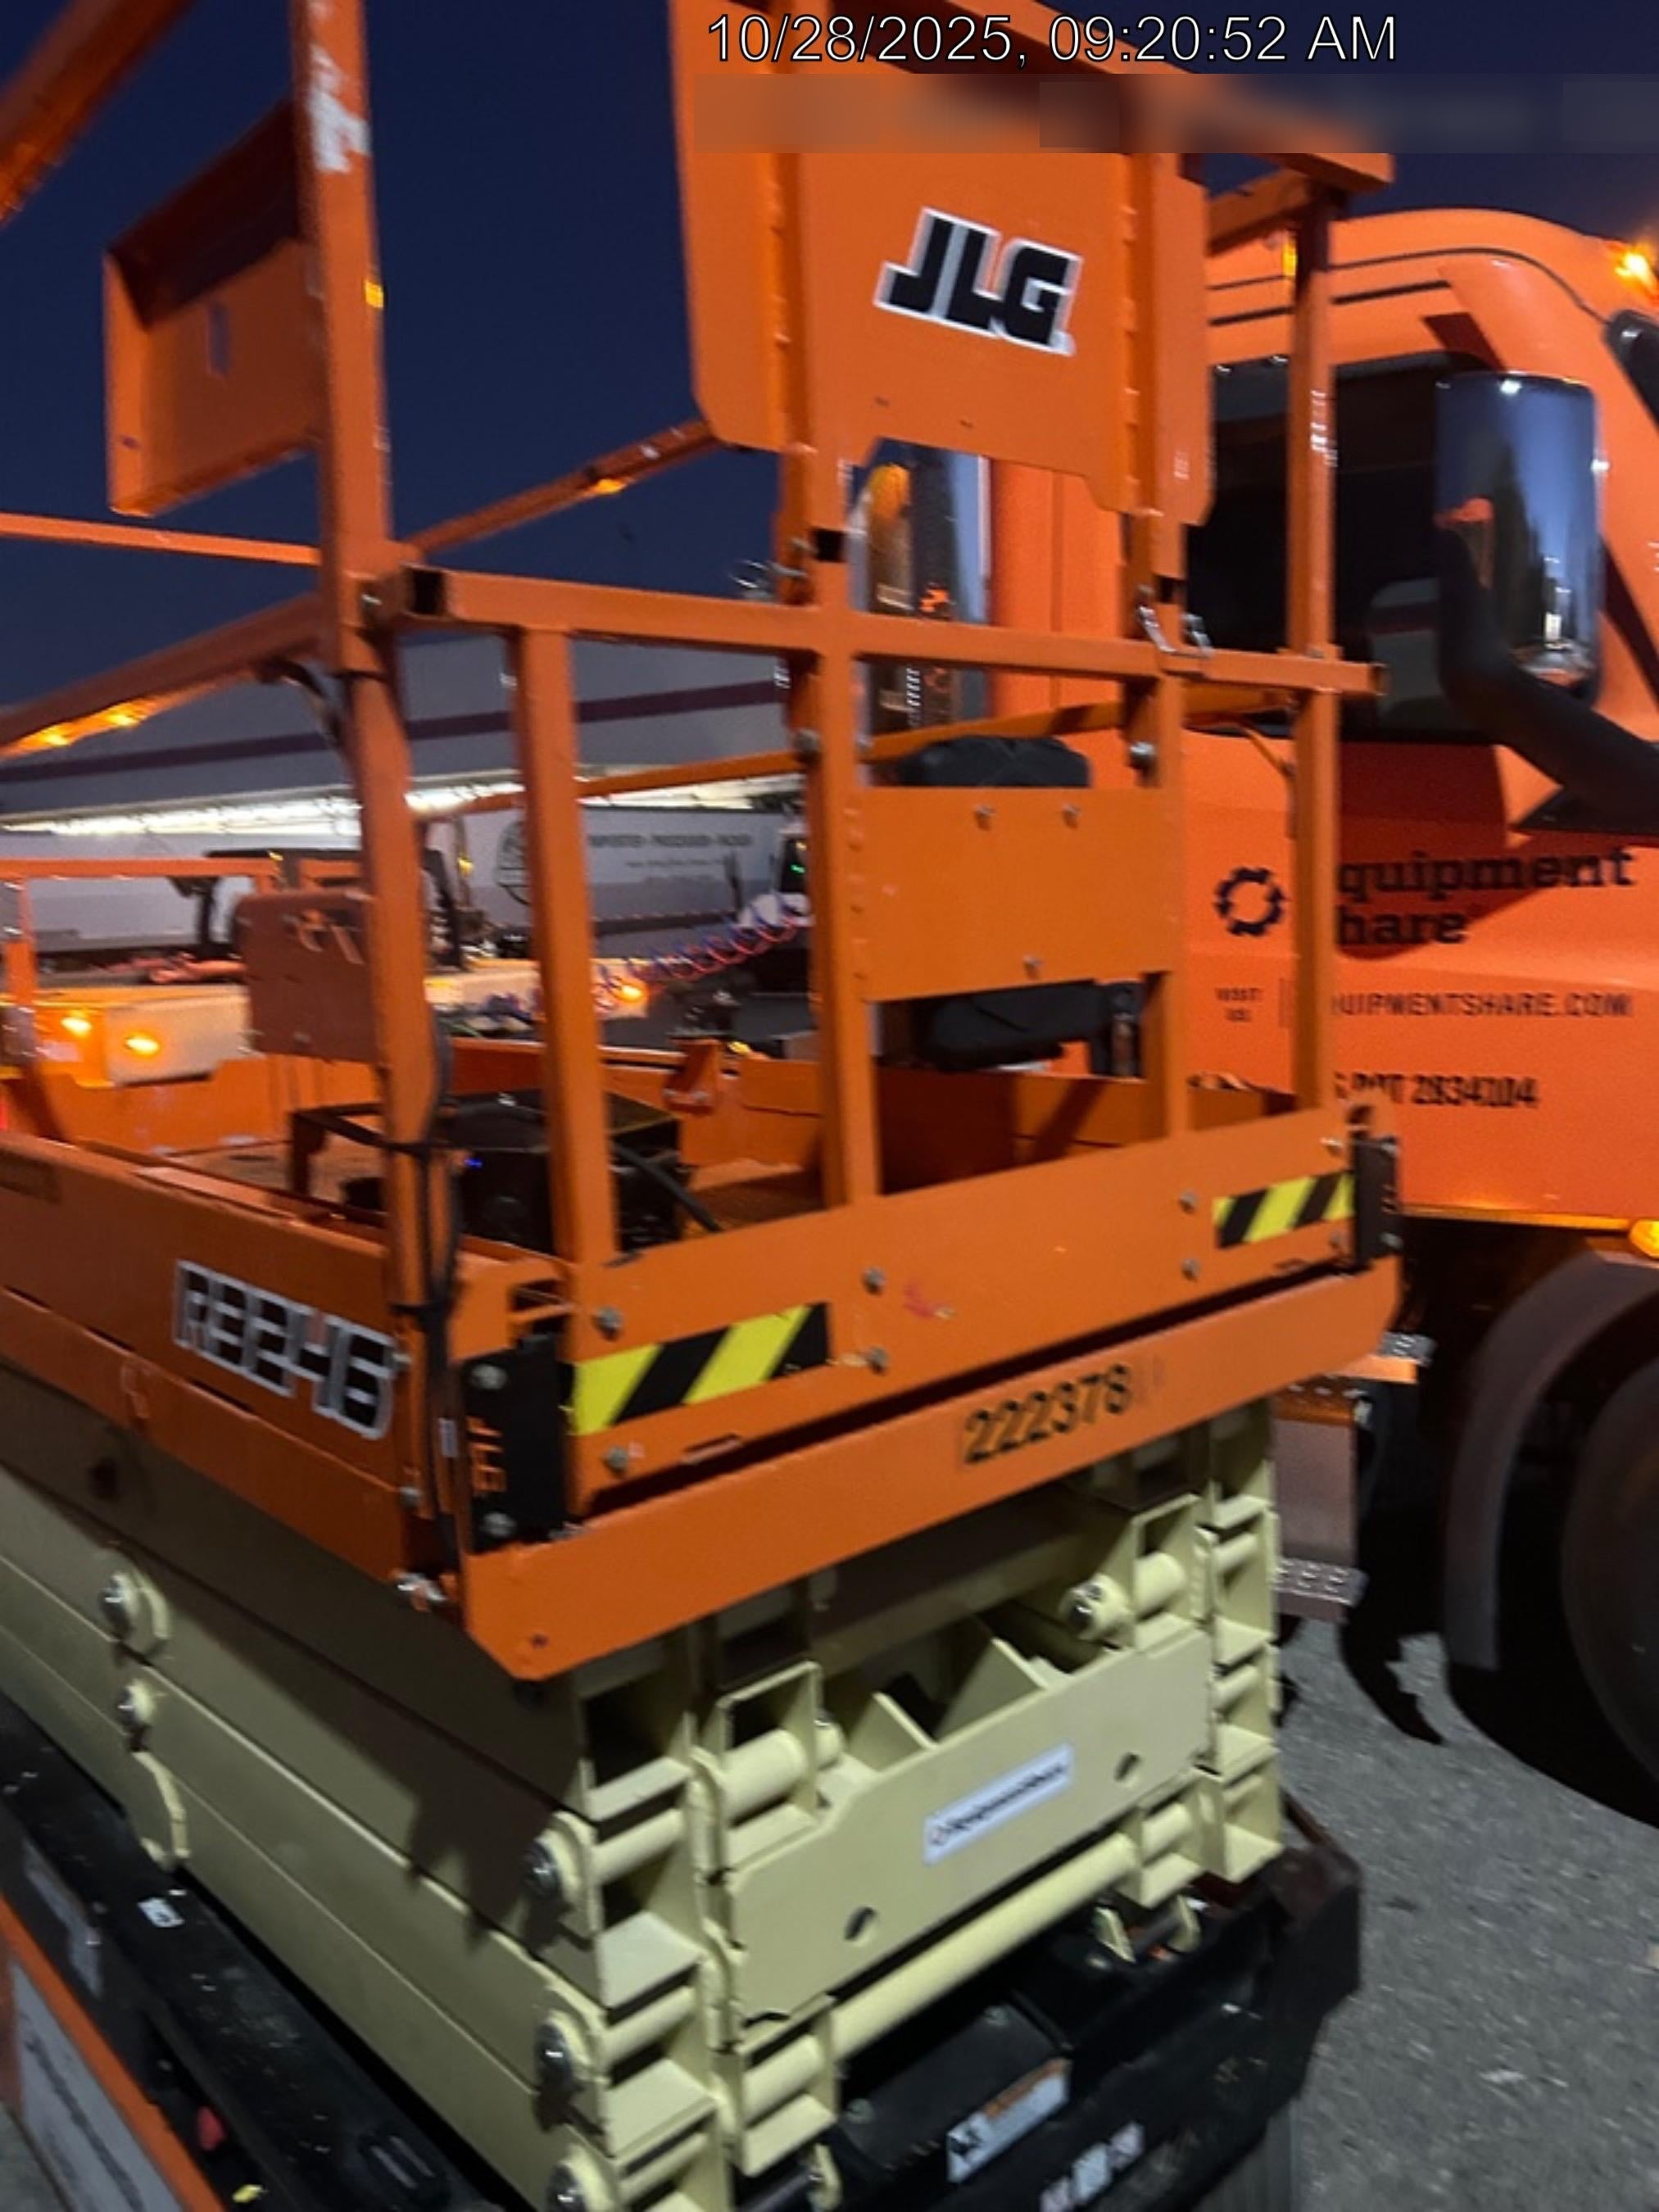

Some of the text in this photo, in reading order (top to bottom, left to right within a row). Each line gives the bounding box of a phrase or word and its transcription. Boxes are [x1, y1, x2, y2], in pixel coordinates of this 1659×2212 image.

[875, 206, 1083, 356] JLG
[1339, 847, 1634, 903] quipment
[1339, 904, 1468, 945] hare
[1334, 993, 1631, 1016] UIPMENTSHARE.COM
[963, 1362, 1131, 1465] 222378
